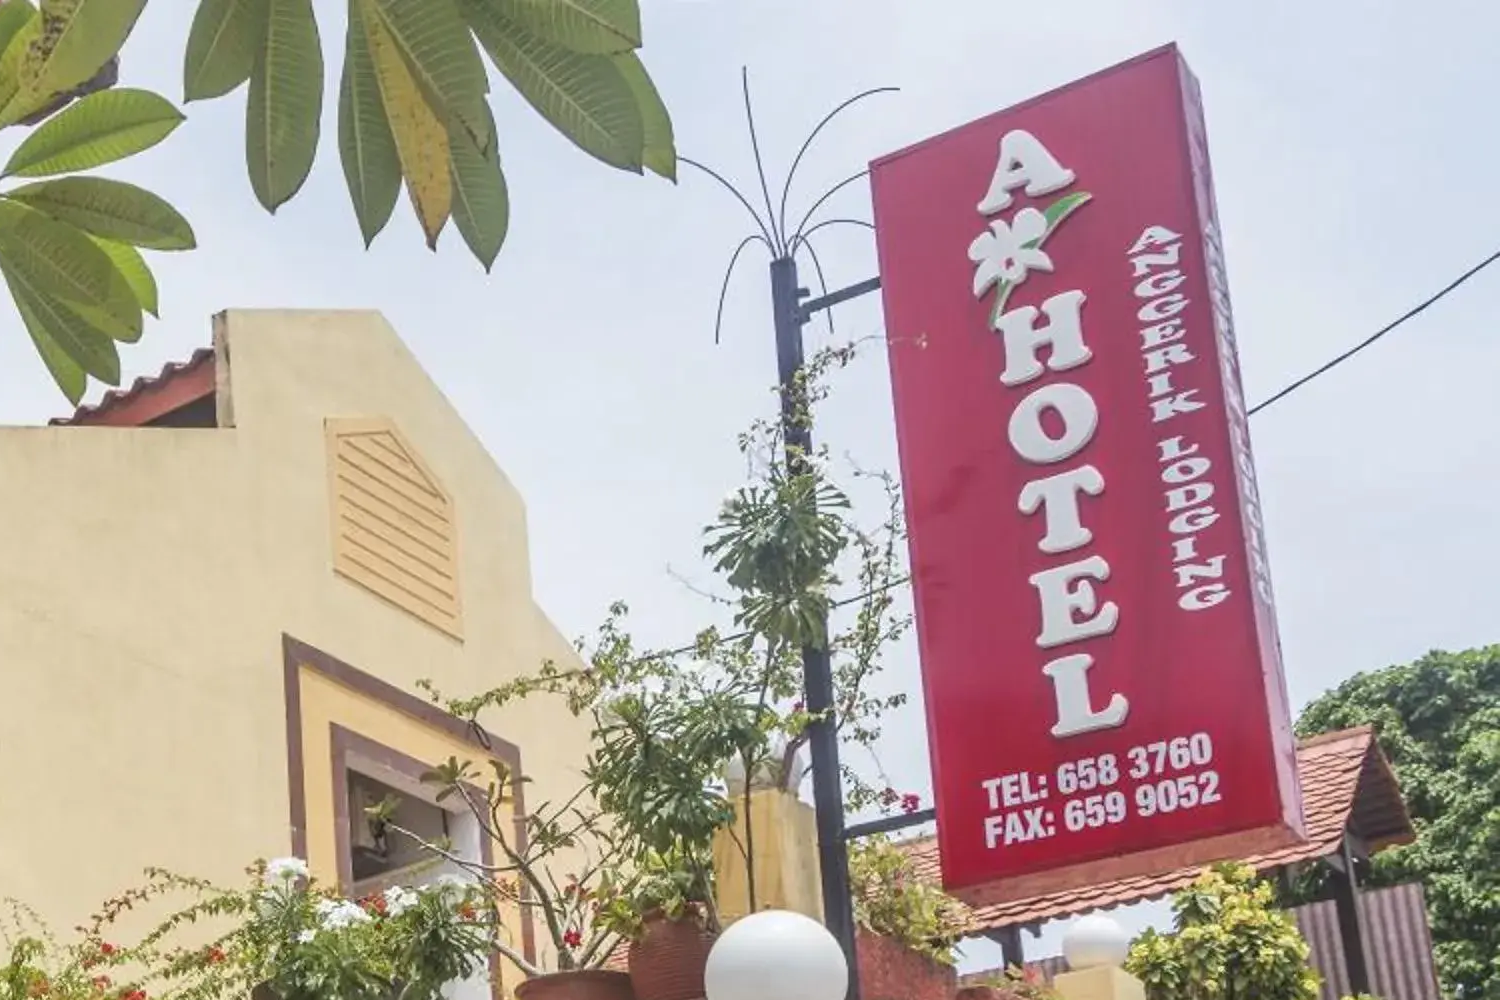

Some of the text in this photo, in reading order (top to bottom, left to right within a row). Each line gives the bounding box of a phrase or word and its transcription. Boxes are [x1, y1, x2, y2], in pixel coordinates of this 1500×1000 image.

[1127, 225, 1207, 423] ANGGERIK
[977, 129, 1130, 739] A HOTEL
[1157, 434, 1231, 612] LODGING
[981, 731, 1214, 811] TEL: 658 3760
[983, 770, 1222, 849] FAX: 659 9052
